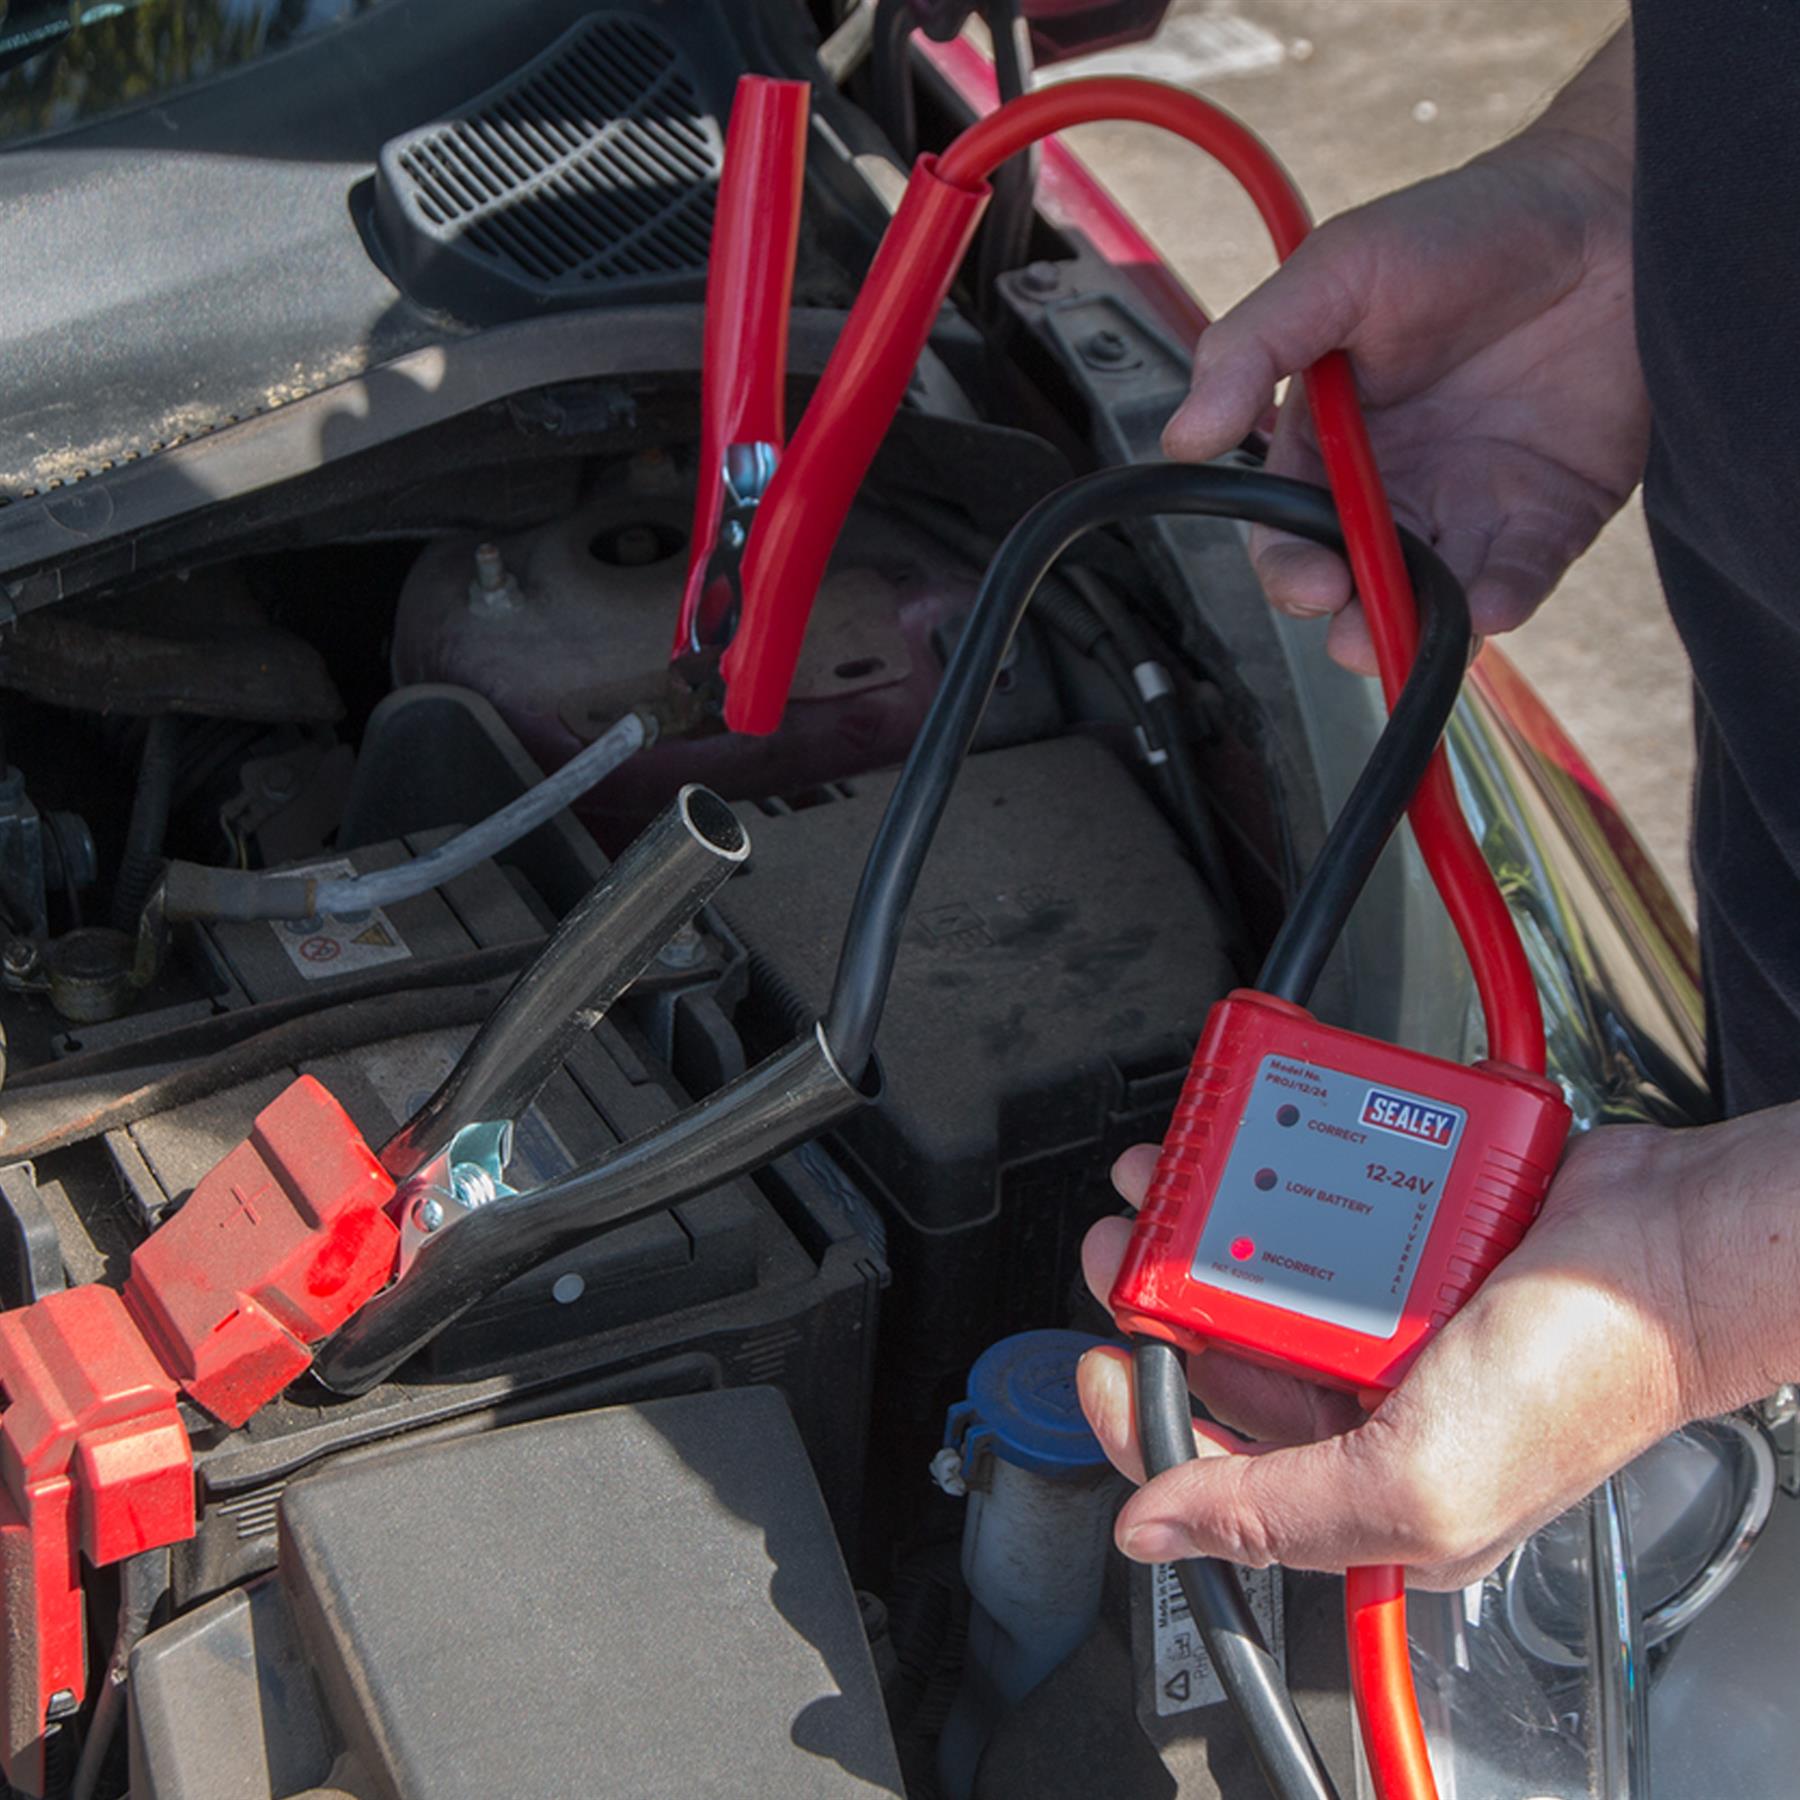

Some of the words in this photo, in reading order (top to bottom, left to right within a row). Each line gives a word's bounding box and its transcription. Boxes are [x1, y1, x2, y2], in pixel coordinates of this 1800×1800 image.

[1270, 1059, 1303, 1077] Model
[1265, 1072, 1328, 1098] PROJ/12/24
[1307, 1119, 1367, 1145] CORRECT
[1370, 1097, 1449, 1139] SEALEY
[1365, 1162, 1435, 1195] 12-24V
[1286, 1181, 1315, 1198] LOW
[1316, 1190, 1374, 1216] BATTERY
[1262, 1250, 1335, 1282] INCORRECT
